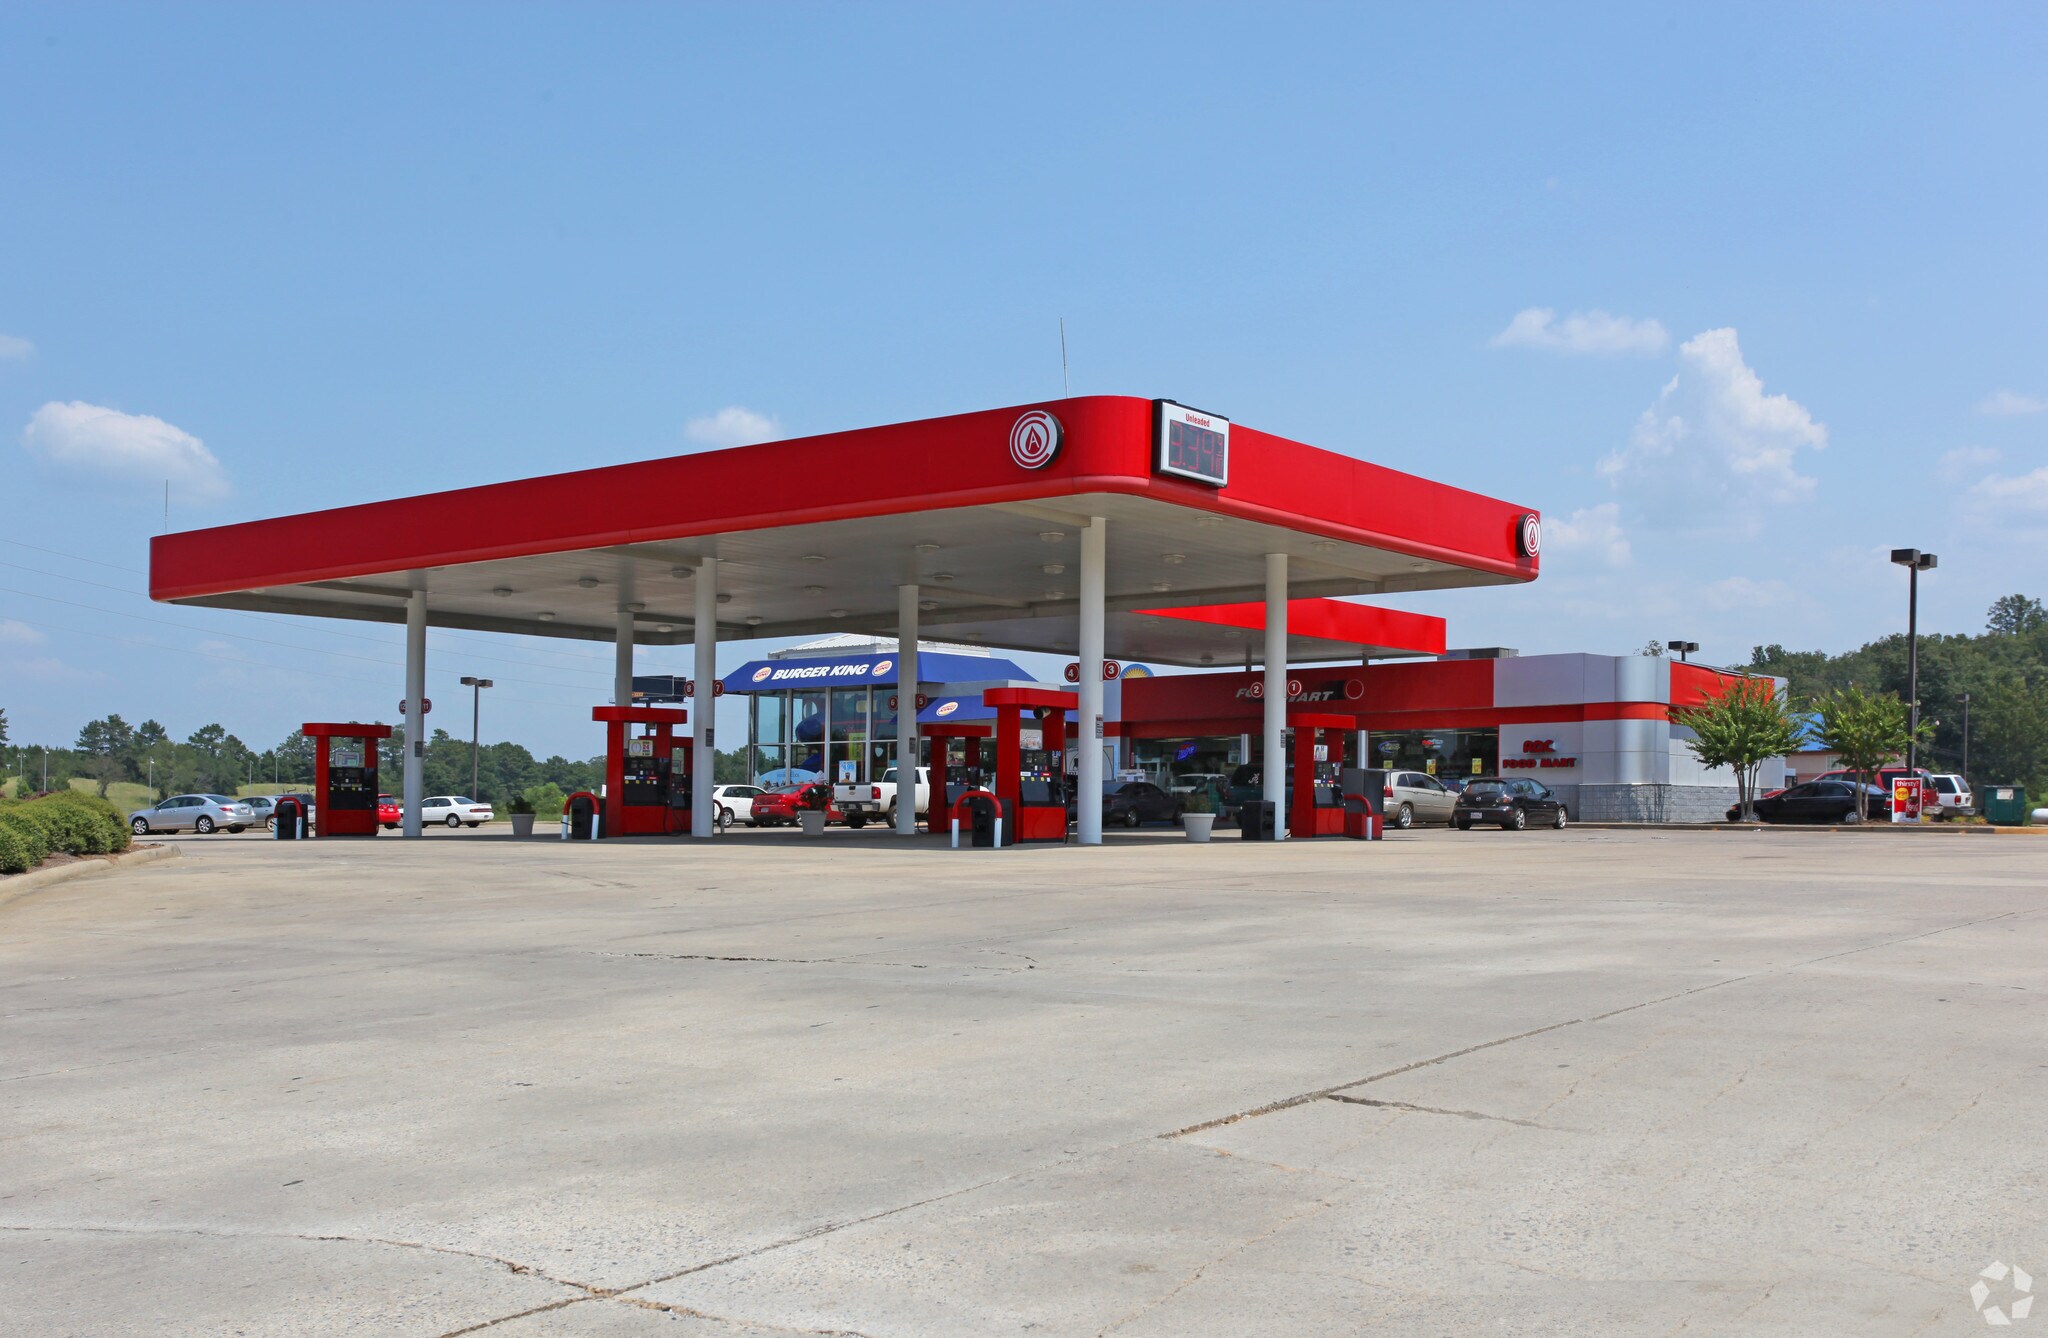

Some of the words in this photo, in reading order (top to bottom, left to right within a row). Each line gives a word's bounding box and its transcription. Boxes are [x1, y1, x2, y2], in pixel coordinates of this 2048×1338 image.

[1185, 413, 1210, 427] Unleaded
[771, 666, 830, 680] BURGER
[829, 664, 869, 676] KING
[1068, 669, 1074, 678] 4
[1108, 666, 1115, 674] 3
[686, 685, 692, 693] 8
[716, 683, 720, 692] 7
[1254, 686, 1259, 694] 2
[1286, 691, 1334, 702] ART
[1502, 759, 1537, 769] FOOD
[1540, 758, 1577, 768] MART
